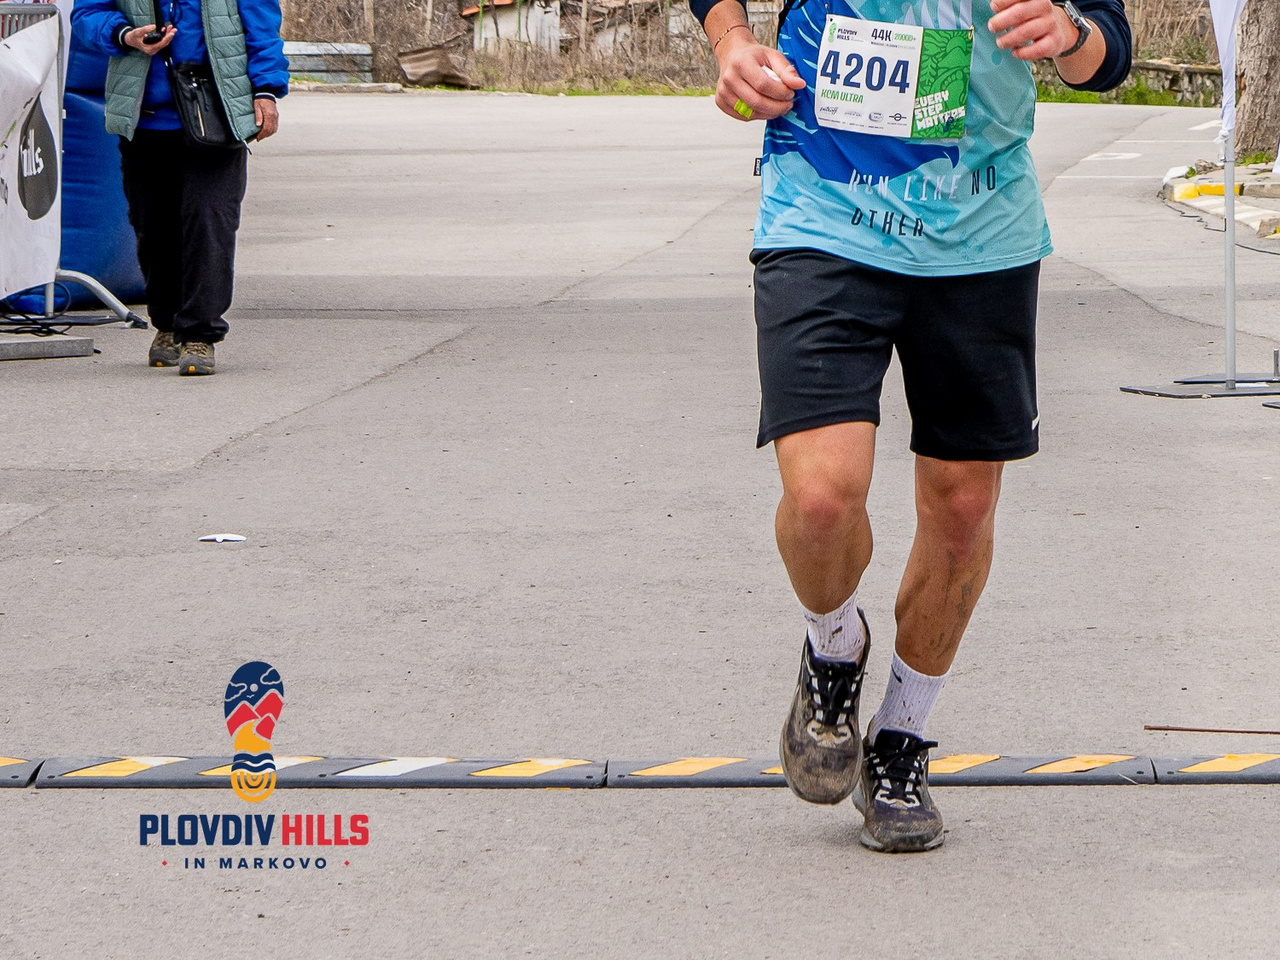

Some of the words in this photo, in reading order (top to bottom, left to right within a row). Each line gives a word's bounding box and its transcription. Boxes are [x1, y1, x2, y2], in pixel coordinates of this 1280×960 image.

[871, 28, 893, 42] 44K
[820, 49, 910, 94] 4204
[971, 165, 996, 196] NO
[851, 207, 925, 237] OTHER
